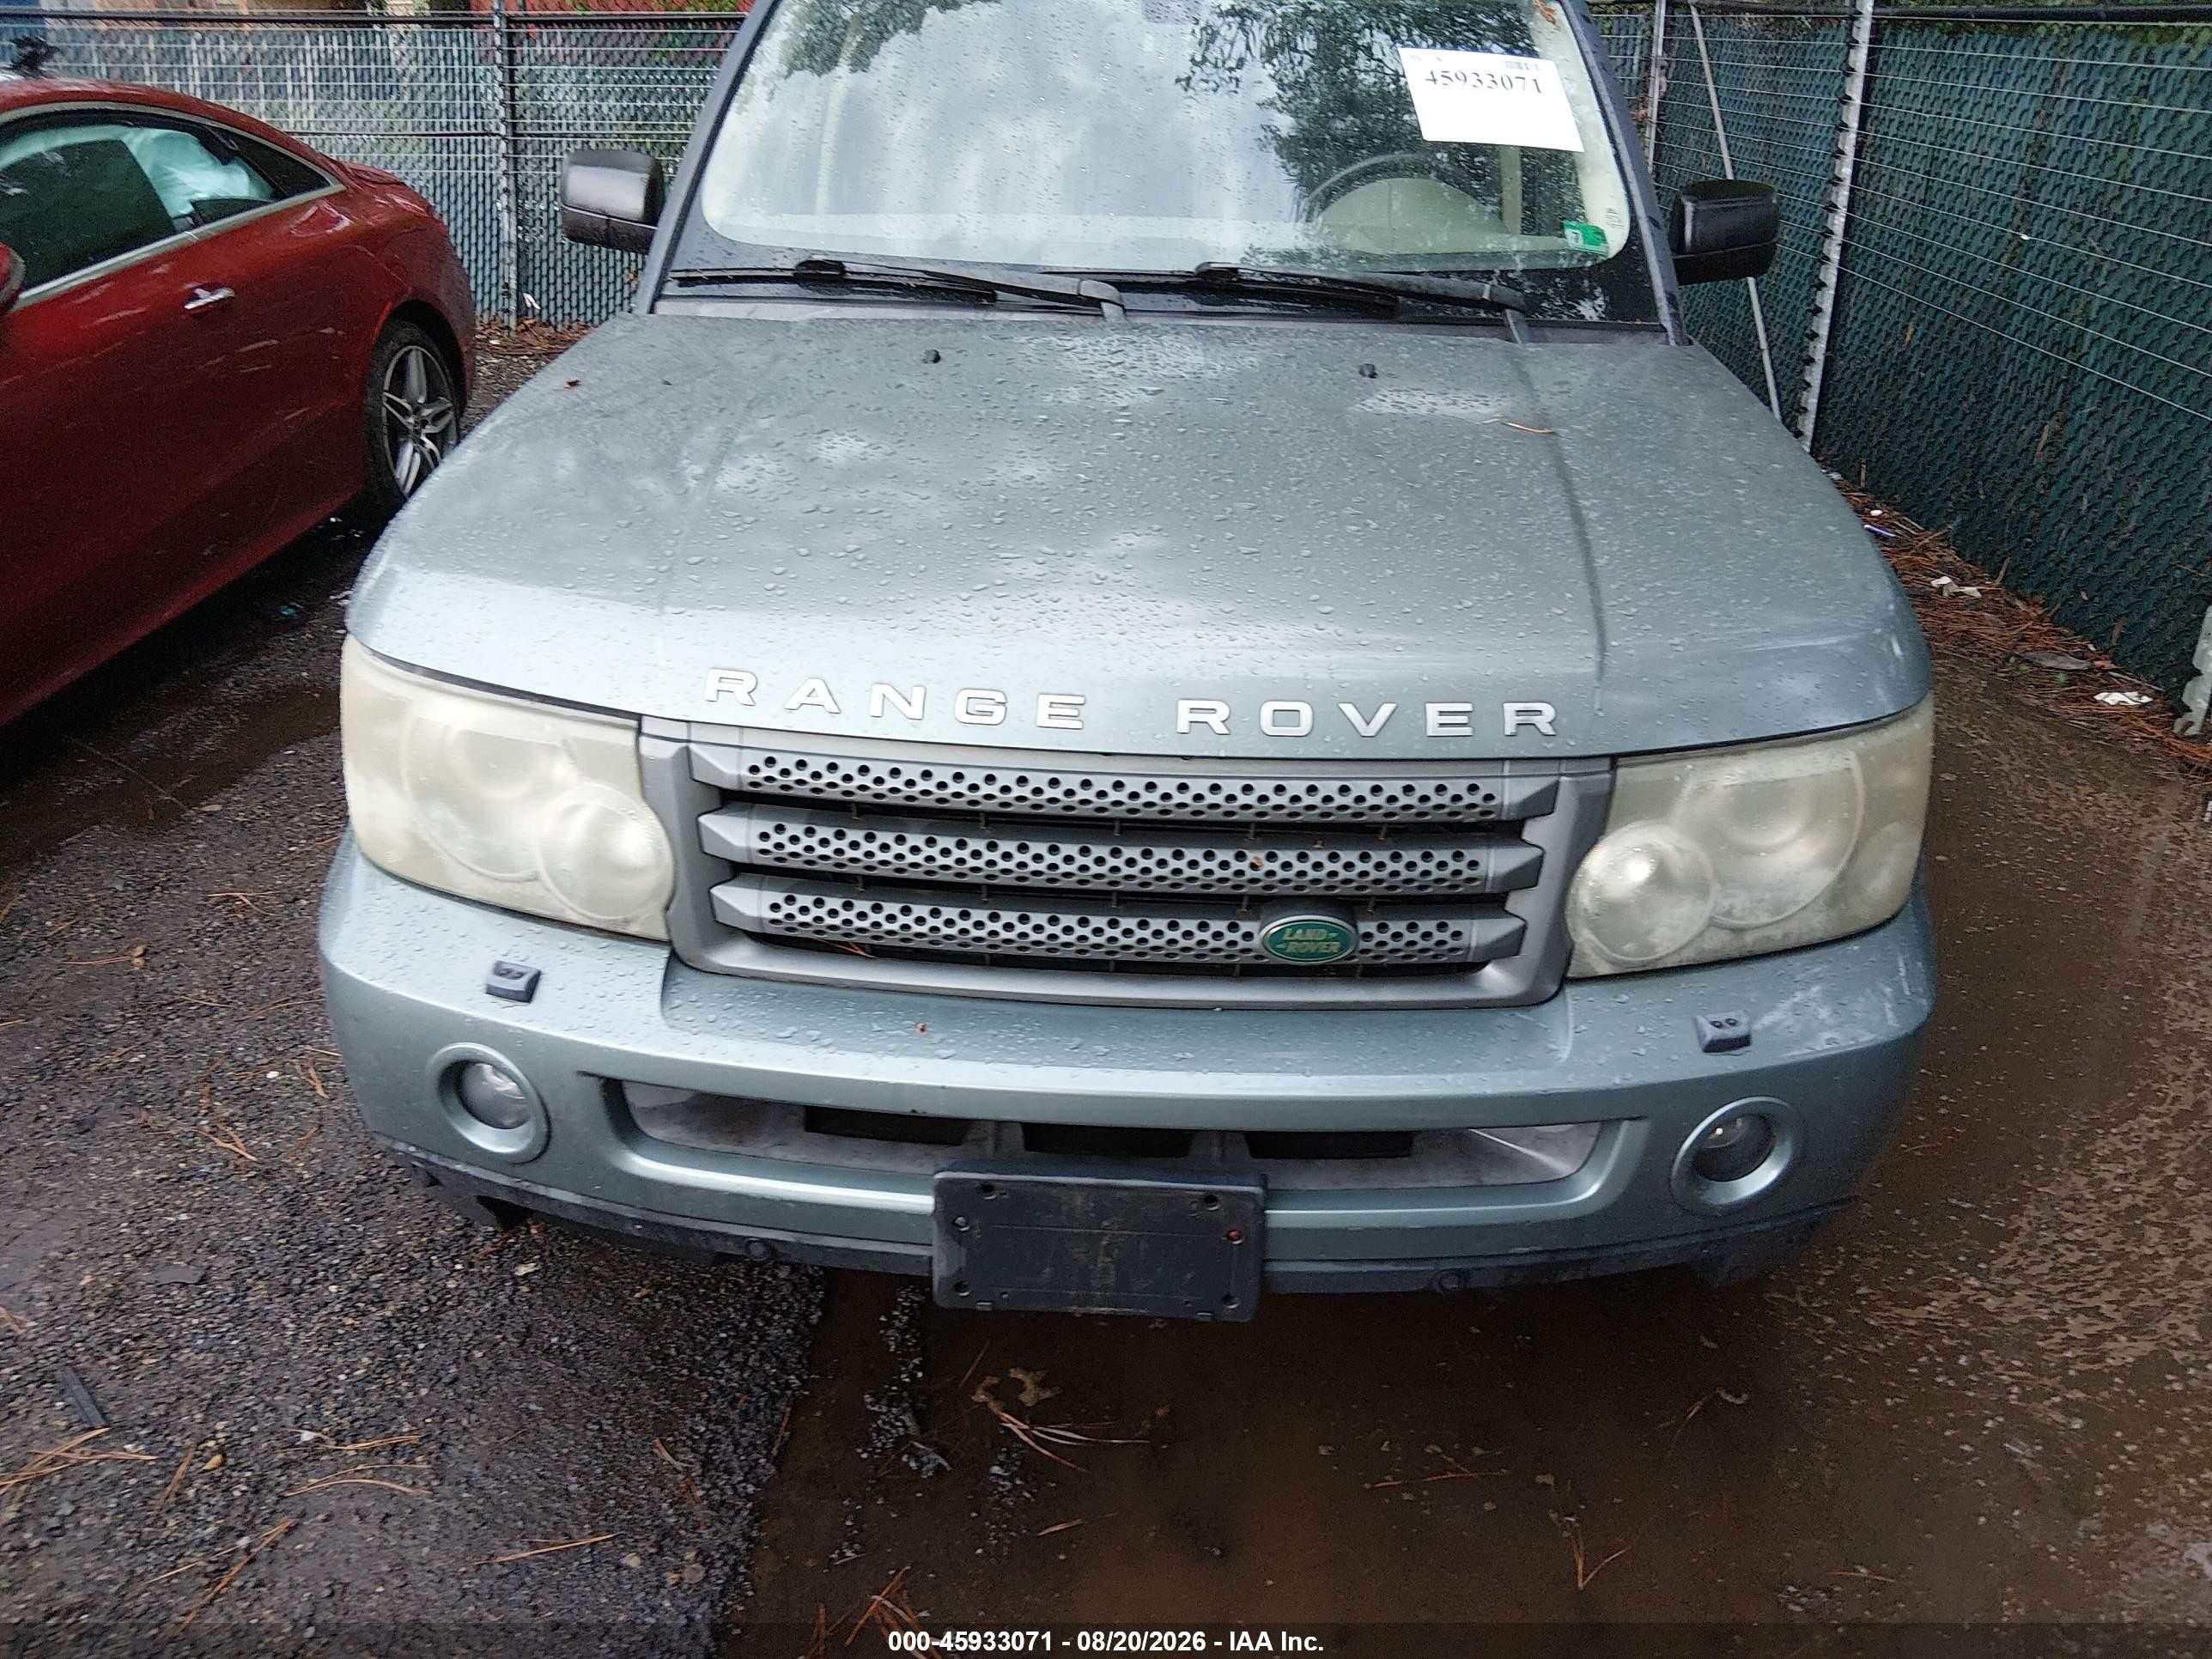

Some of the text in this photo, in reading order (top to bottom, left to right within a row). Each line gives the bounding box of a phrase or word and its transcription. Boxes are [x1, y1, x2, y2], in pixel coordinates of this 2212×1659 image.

[1425, 70, 1542, 94] 45933071
[703, 666, 1557, 738] RANGE ROVER
[1283, 928, 1328, 940] LAND
[1286, 941, 1340, 953] ROVER
